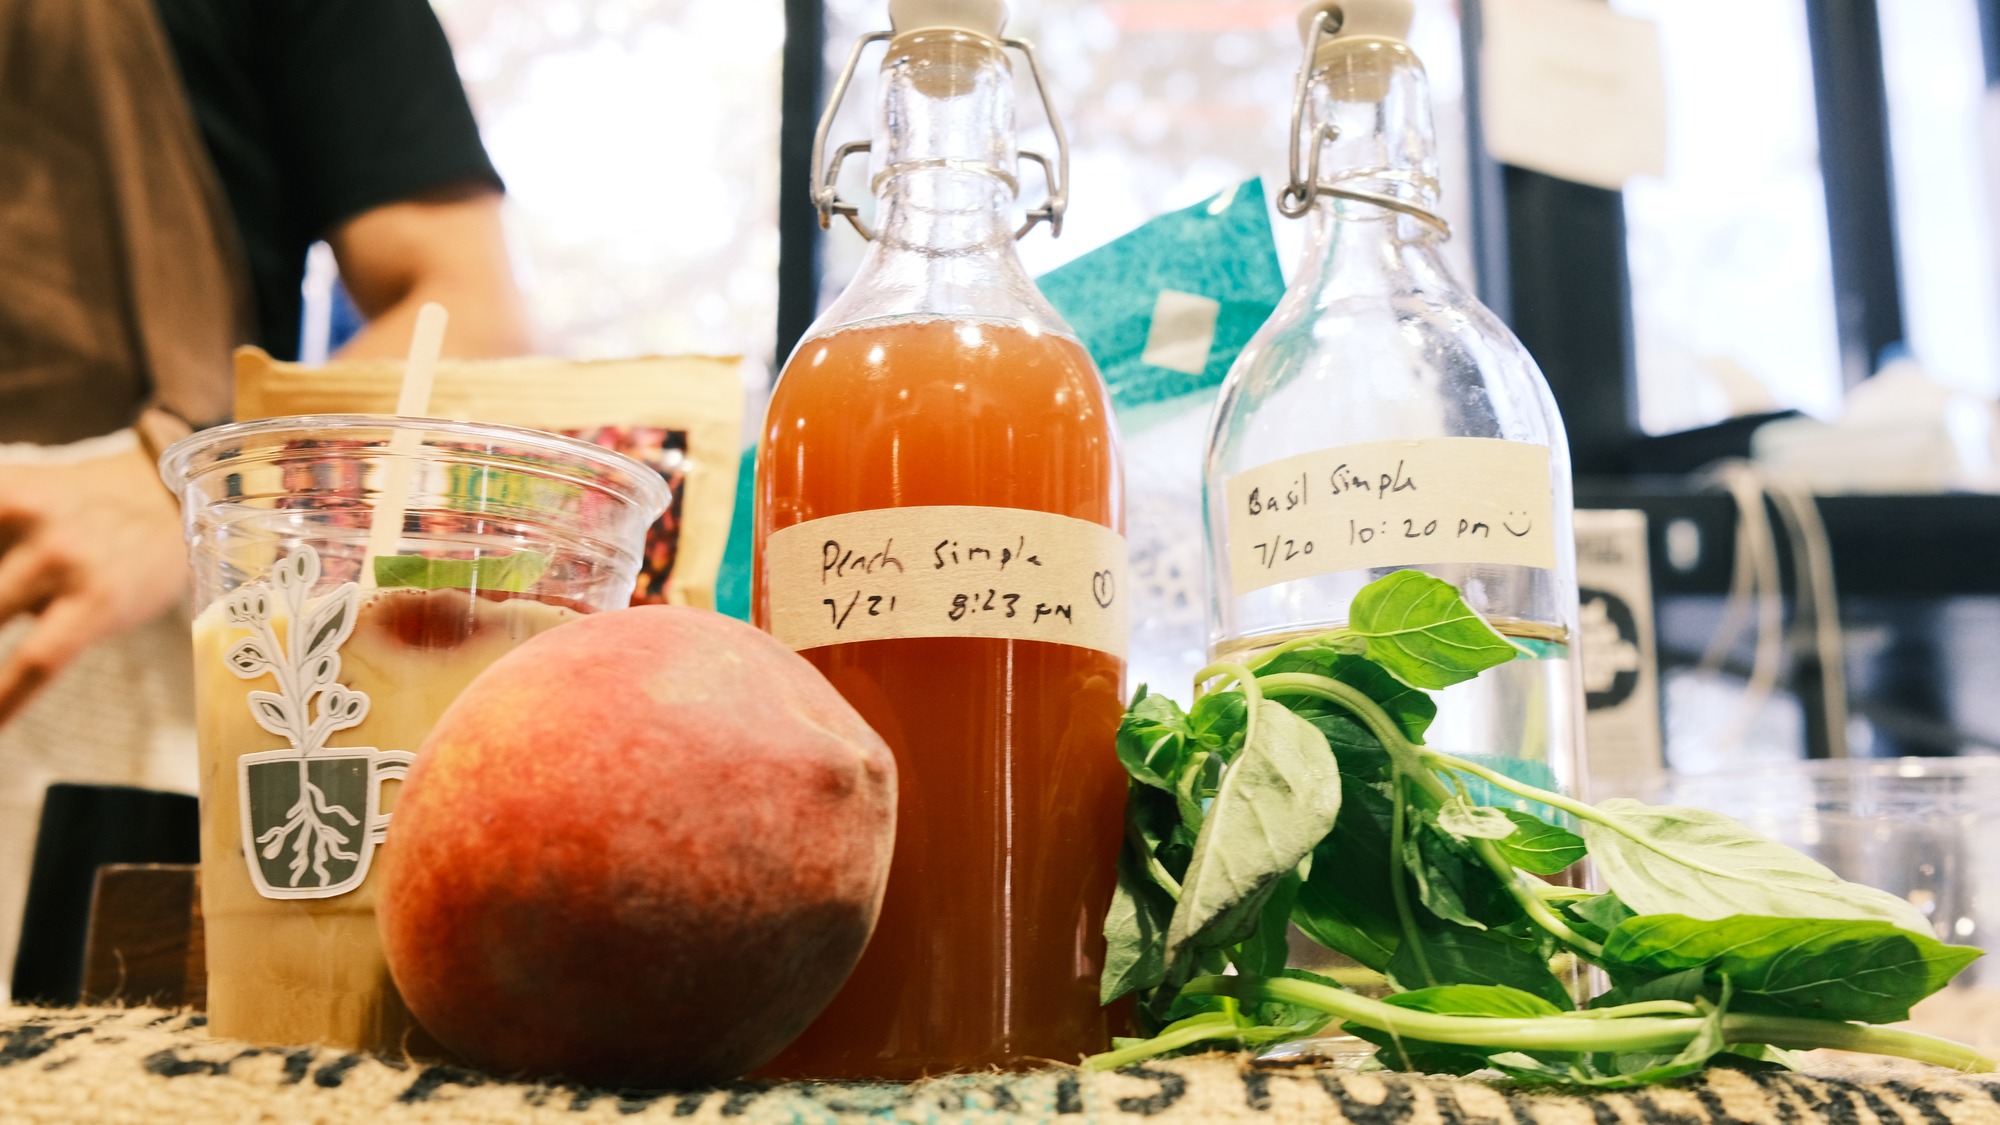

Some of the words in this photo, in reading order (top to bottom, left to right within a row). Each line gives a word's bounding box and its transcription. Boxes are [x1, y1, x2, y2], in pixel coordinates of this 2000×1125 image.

[1248, 472, 1308, 516] Basil
[1331, 460, 1417, 499] Simple
[822, 537, 904, 585] Peach
[1253, 535, 1314, 569] 7/20
[823, 590, 896, 630] 7/21
[948, 588, 1021, 622] 8:23
